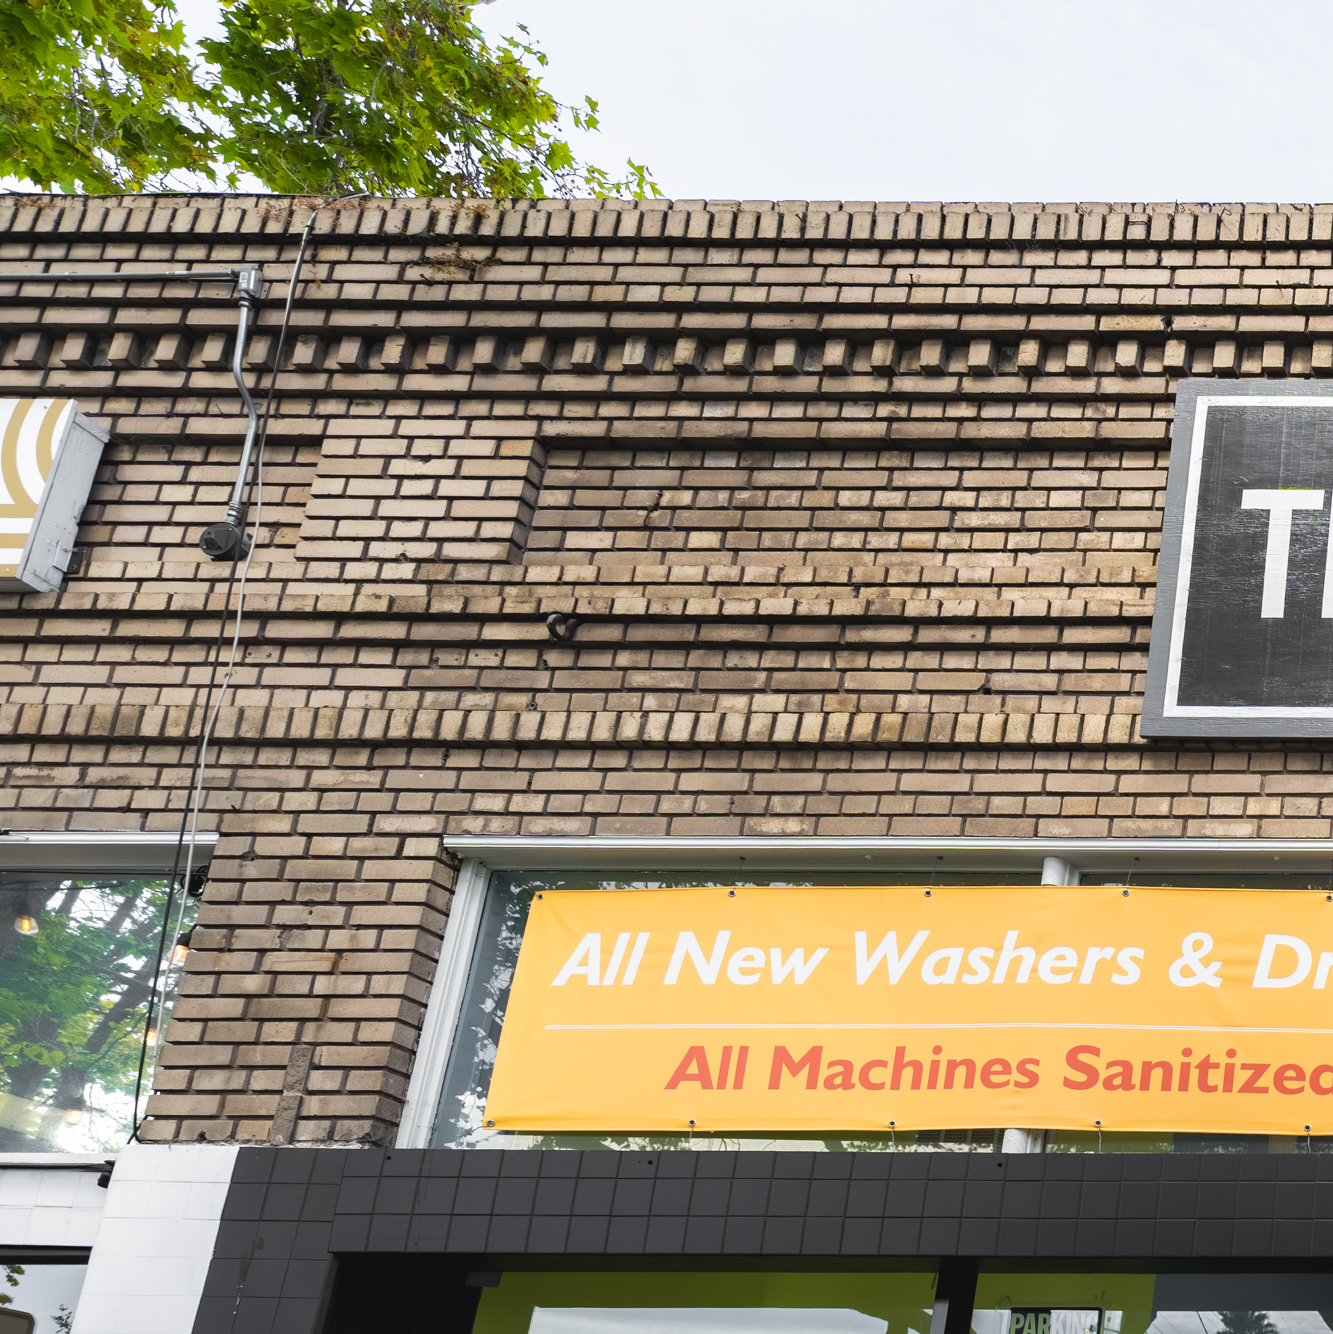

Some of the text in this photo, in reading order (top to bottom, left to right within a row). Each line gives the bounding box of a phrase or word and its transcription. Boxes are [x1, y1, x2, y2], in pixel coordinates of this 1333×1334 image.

[551, 931, 651, 987] All
[663, 930, 829, 986] New
[854, 929, 1145, 986] Washers
[1168, 931, 1223, 988] &
[665, 1045, 749, 1090] All
[768, 1045, 1040, 1091] Machines
